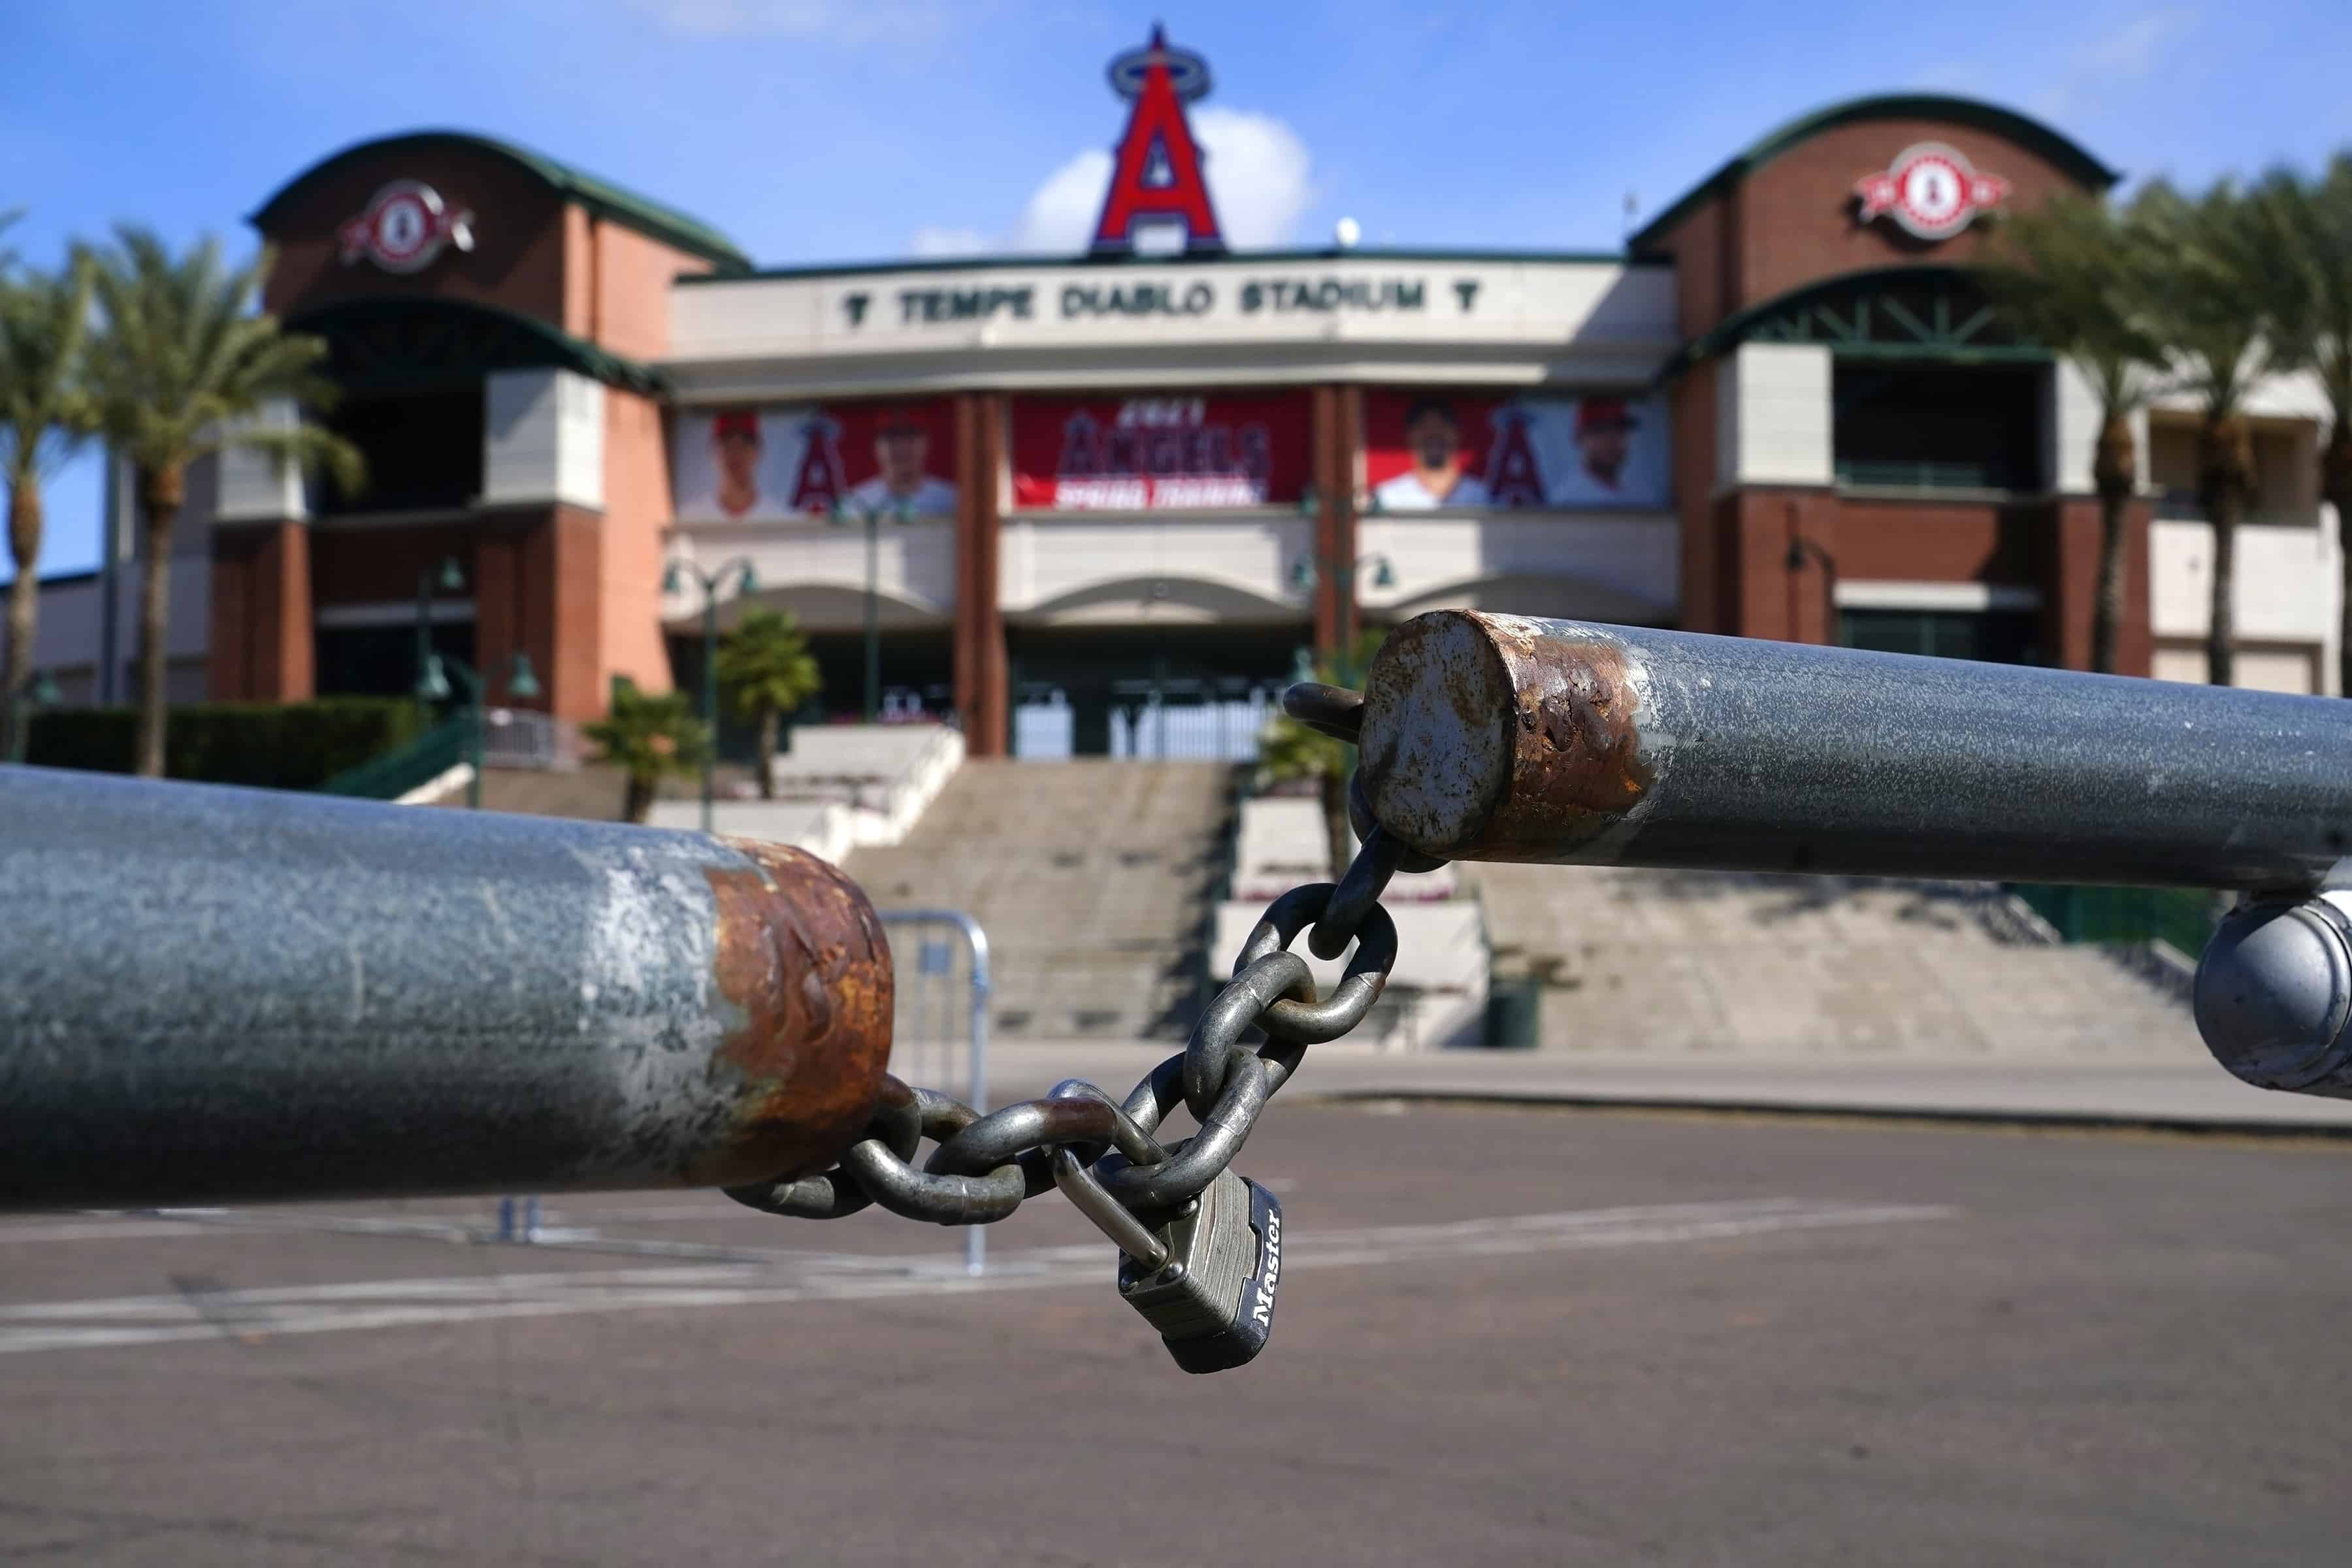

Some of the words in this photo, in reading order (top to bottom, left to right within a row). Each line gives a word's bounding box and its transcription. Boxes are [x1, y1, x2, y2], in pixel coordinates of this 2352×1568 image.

[1087, 16, 1230, 259] A
[898, 285, 1036, 324] TEMPE
[1060, 280, 1213, 319] DIABLO
[1239, 279, 1425, 315] STADIUM
[1254, 1209, 1281, 1327] Master
